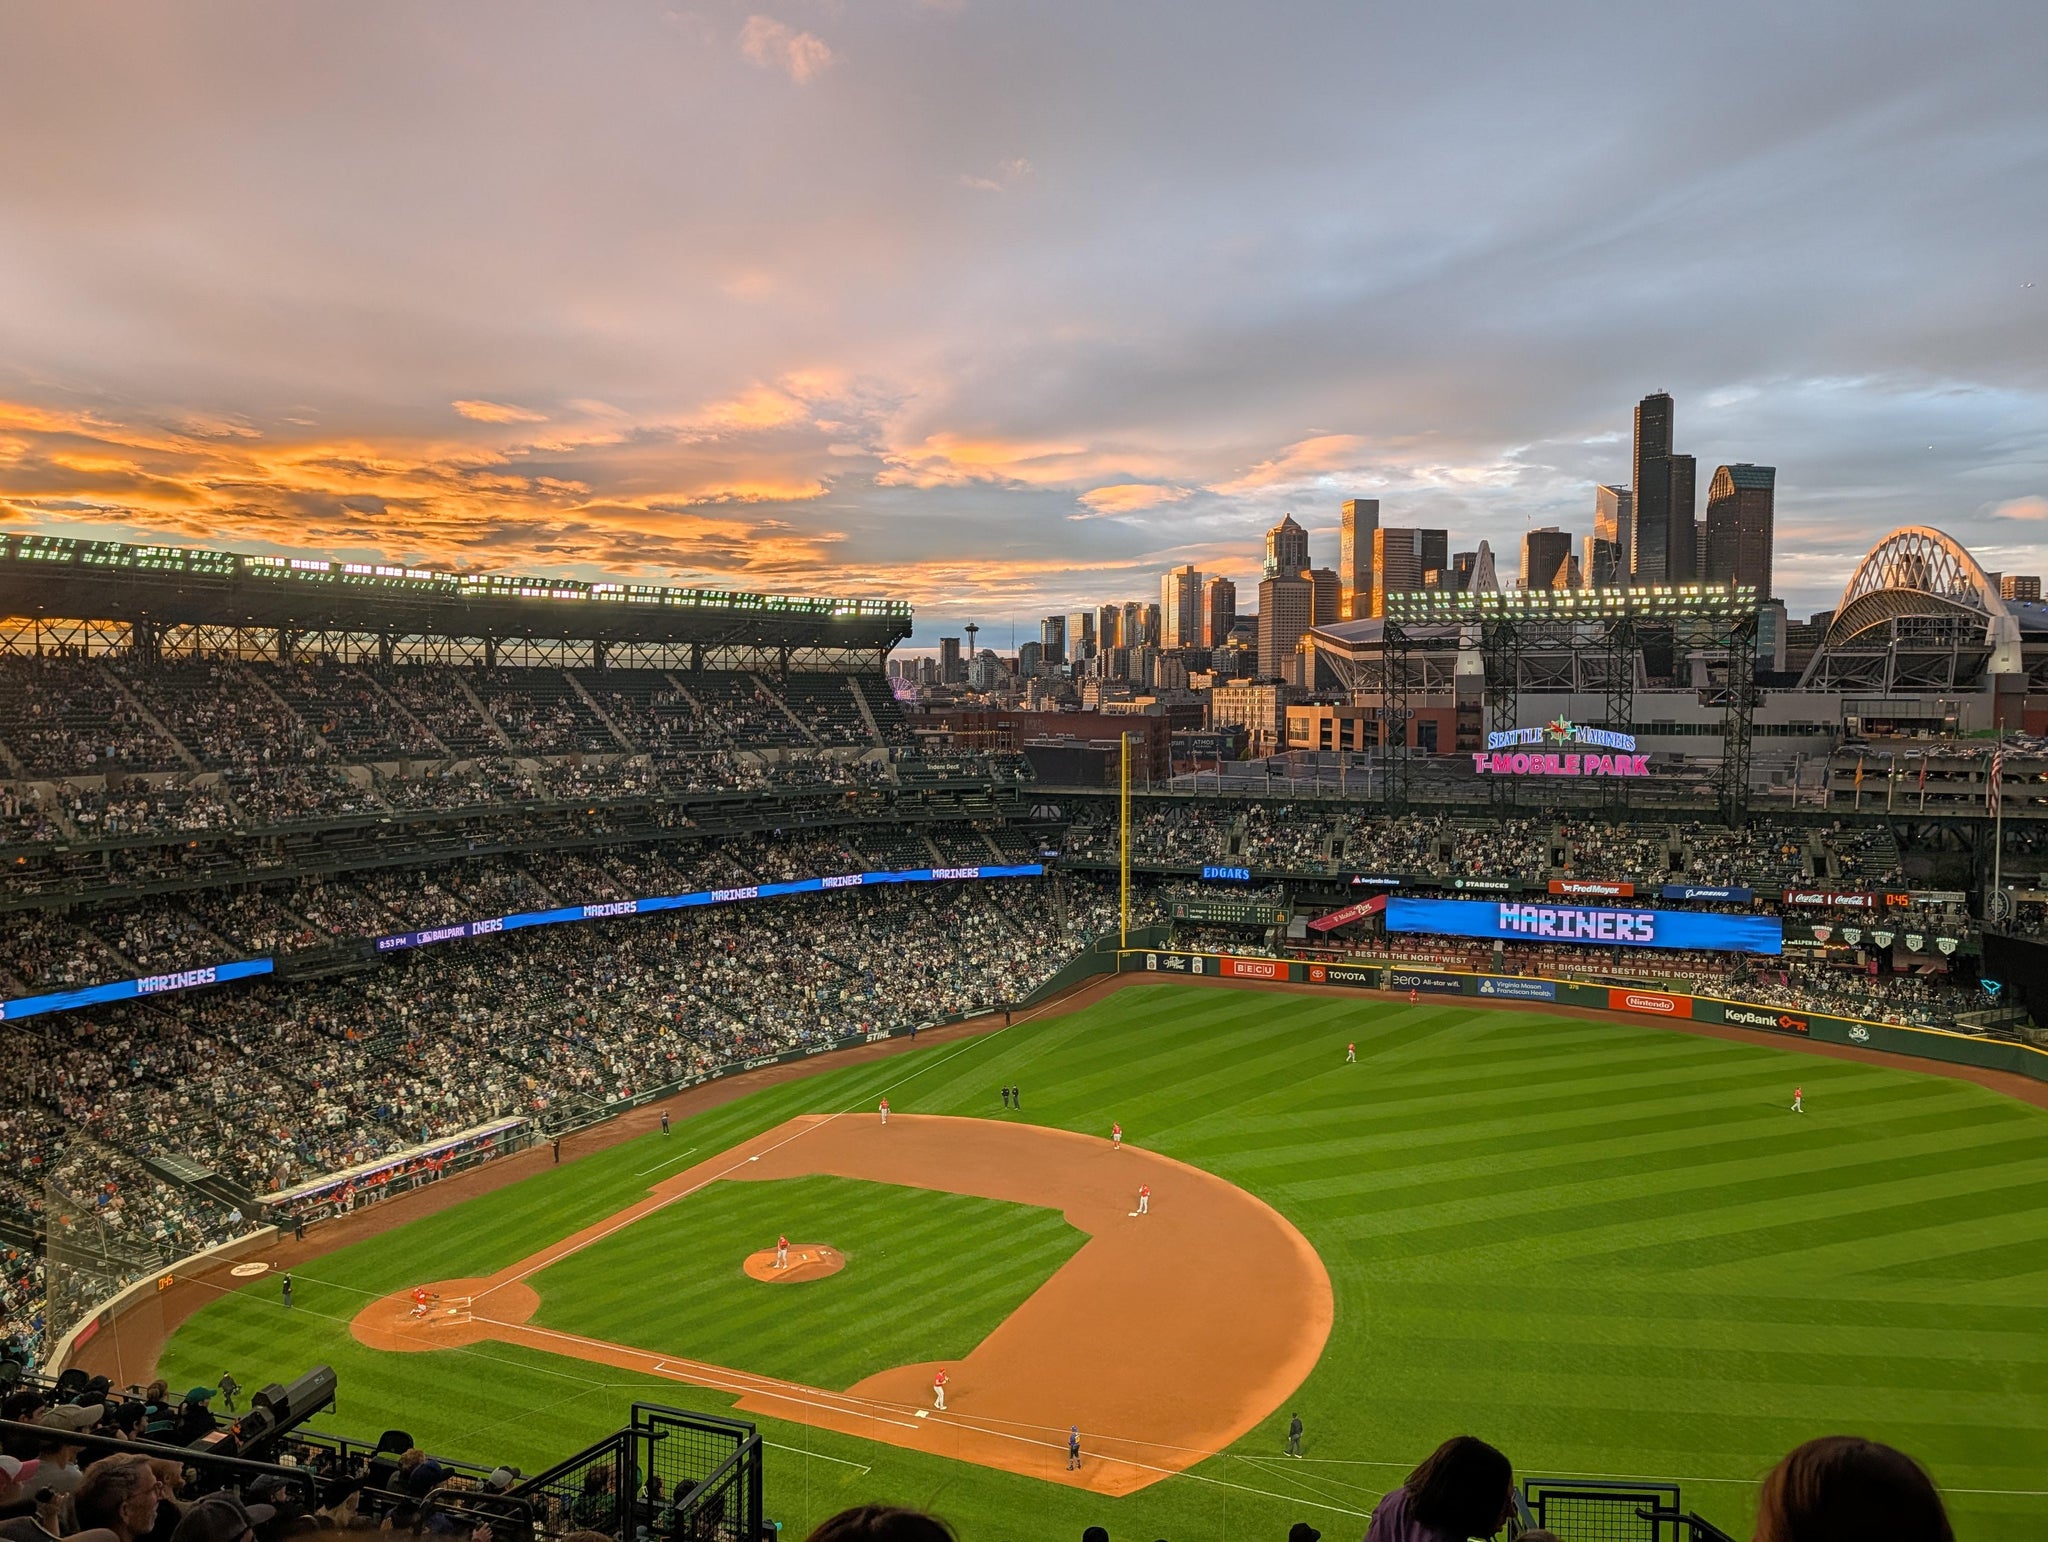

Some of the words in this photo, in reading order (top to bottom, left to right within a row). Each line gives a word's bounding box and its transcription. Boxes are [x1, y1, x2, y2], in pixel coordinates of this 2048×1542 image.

[1488, 728, 1543, 750] SEATTLE
[1575, 726, 1636, 751] MARINERS
[1473, 753, 1580, 775] T-MOBILE
[1584, 754, 1650, 776] PARK
[932, 868, 979, 879] MARINERS
[822, 874, 862, 887] MARINERS
[1466, 881, 1509, 889] STARBUCKS
[711, 887, 757, 901] MARINERS
[1887, 894, 1908, 906] 0:45
[584, 901, 637, 917] MARINERS
[1500, 903, 1654, 941] MARINERS
[380, 939, 394, 948] 8:53
[396, 938, 406, 946] PM
[433, 927, 464, 940] BALLPARK
[1237, 963, 1272, 974] BECU
[137, 968, 216, 992] MARINERS
[1329, 971, 1366, 981] TOYOTA
[1674, 971, 1731, 980] NORTHWES
[1631, 998, 1670, 1008] Nintendo
[1725, 1009, 1777, 1026] KeyBank
[866, 1030, 891, 1042] STIHL
[1853, 1028, 1865, 1036] 50
